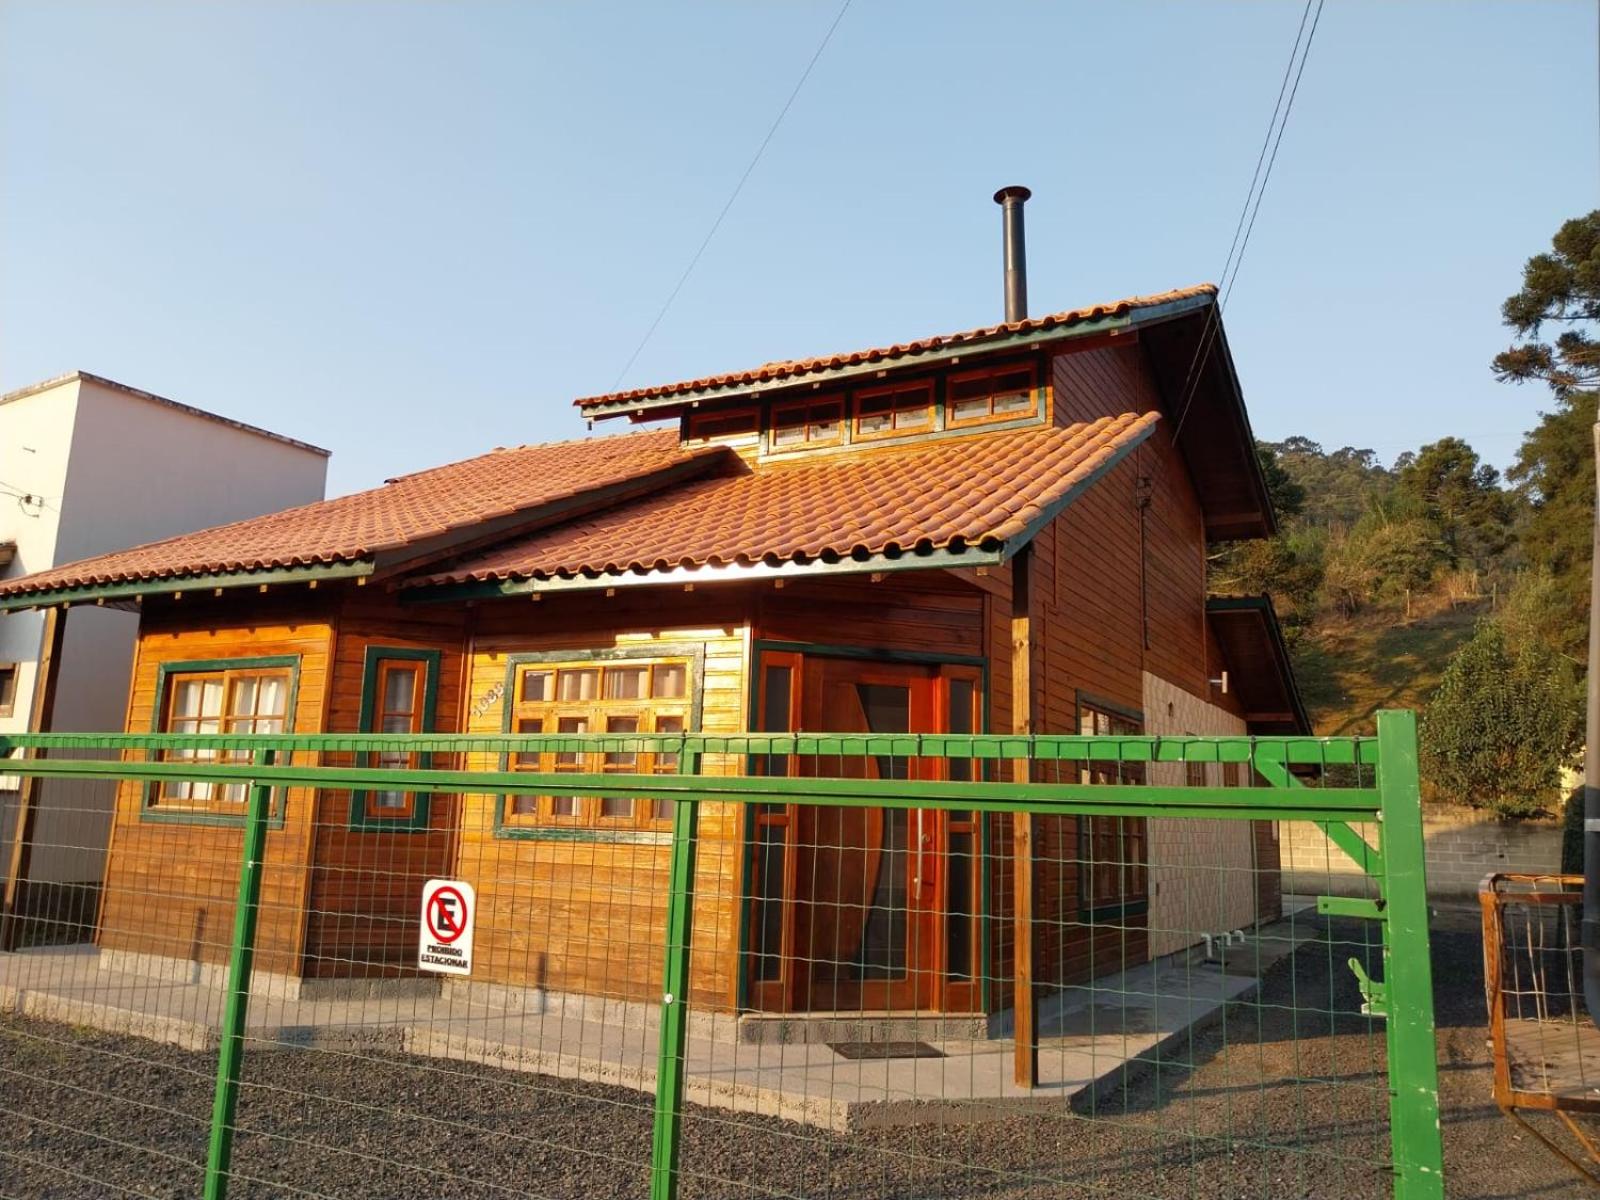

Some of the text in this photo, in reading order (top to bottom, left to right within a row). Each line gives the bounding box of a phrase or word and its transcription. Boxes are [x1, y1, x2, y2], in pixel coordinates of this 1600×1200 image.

[437, 899, 456, 930] E
[427, 945, 463, 957] PROIBIDO
[421, 954, 468, 968] ESTACIONAR
